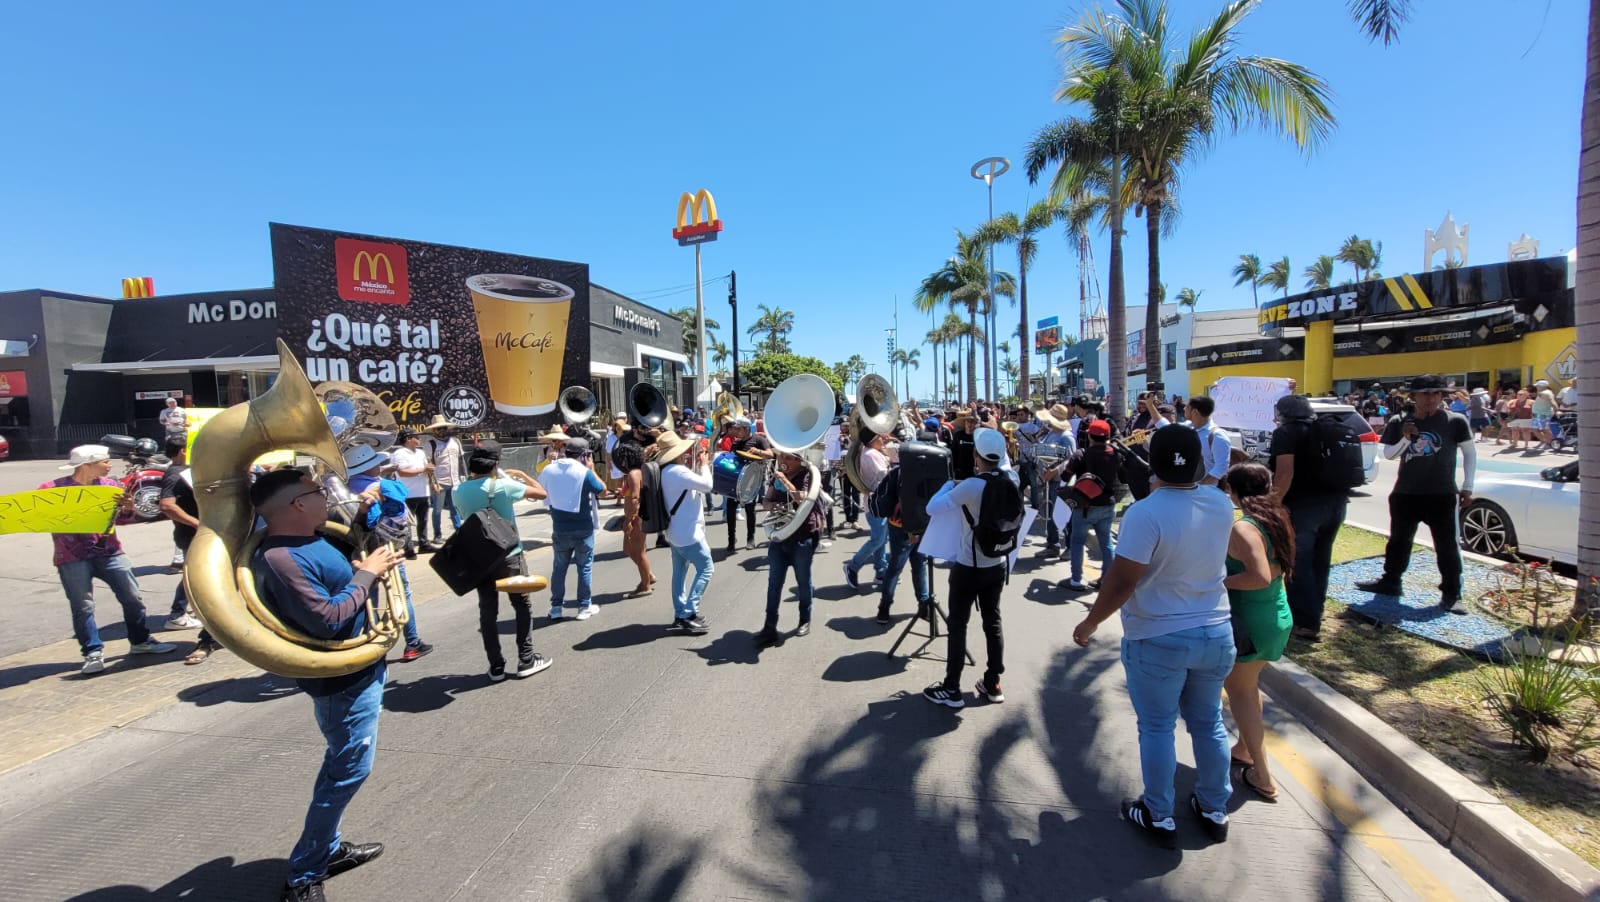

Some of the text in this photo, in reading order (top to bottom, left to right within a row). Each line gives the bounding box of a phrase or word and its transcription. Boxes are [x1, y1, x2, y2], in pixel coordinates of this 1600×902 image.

[360, 281, 388, 289] México
[367, 287, 396, 295] encanta
[614, 304, 661, 332] McDonald's
[306, 312, 440, 352] ¿Qué tal
[1414, 330, 1472, 343] CHEVEZONE
[495, 331, 554, 353] McCafé
[305, 351, 444, 384] un café?
[448, 398, 479, 410] 100%
[1173, 452, 1187, 466] LA
